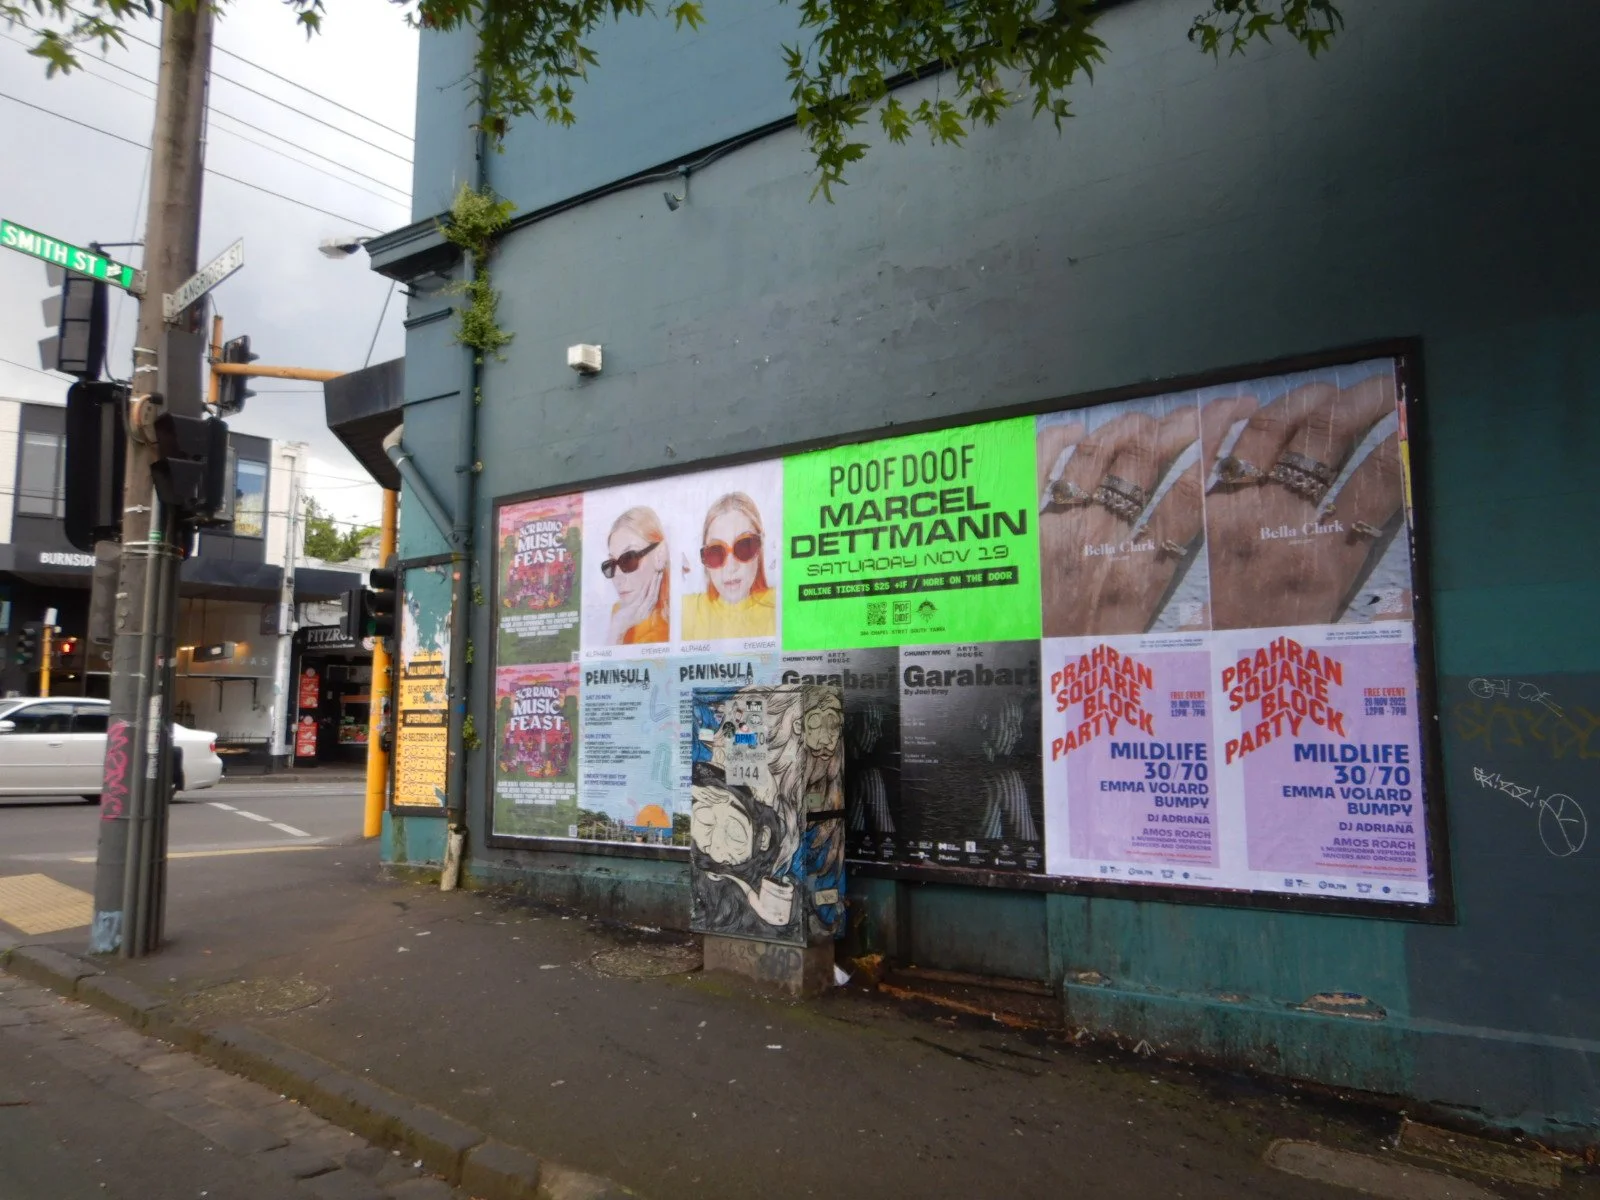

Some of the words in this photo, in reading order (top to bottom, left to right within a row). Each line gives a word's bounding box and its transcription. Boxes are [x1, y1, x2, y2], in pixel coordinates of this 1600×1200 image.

[2, 225, 68, 265] SMITH
[73, 251, 98, 274] ST
[820, 485, 991, 529] MARCEL
[517, 533, 563, 552] MUSIC
[790, 508, 1028, 559] DETTMANN
[1260, 526, 1297, 540] Bella
[514, 548, 567, 568] FEAST
[1084, 543, 1116, 556] Bella
[807, 552, 917, 576] SATURDAY
[924, 548, 970, 565] NOV
[978, 545, 1009, 560] 19
[803, 587, 832, 596] ONLINE
[836, 584, 870, 594] TICKETS
[950, 575, 961, 585] ON
[966, 573, 983, 583] THE
[988, 571, 1013, 581] DOOR
[641, 647, 670, 655] EYEWEAR
[680, 662, 754, 682] PENINSULA
[1051, 643, 1153, 695] PRAHRAN
[1222, 635, 1342, 692] PRAHRAN
[585, 668, 650, 686] PENINSULA
[903, 660, 1038, 688] Garabari
[533, 686, 560, 698] RADIO
[1056, 664, 1141, 713] SQUARE
[1229, 659, 1329, 712] SQUARE
[1364, 688, 1380, 696] FREE
[1382, 688, 1405, 696] EVENT
[513, 699, 561, 716] MUSIC
[1374, 697, 1388, 706] NOV
[1391, 706, 1407, 716] 7PM
[1083, 690, 1154, 737] BLOCK
[1261, 685, 1346, 738] BLOCK
[510, 715, 565, 731] FEAST
[1051, 711, 1118, 761] PARTY
[1225, 709, 1304, 765] PARTY
[1110, 742, 1208, 761] MILDLIFE
[1294, 743, 1410, 764] MILDLIFE
[1144, 762, 1208, 781] 30/70
[1334, 765, 1411, 786] 30/70
[1100, 780, 1145, 793] EMMA
[1148, 782, 1209, 795] VOLARD
[1282, 785, 1335, 799] EMMA
[1339, 786, 1412, 801] VOLARD
[1154, 796, 1209, 809] BUMPY
[1347, 802, 1413, 817] BUMPY
[1147, 814, 1159, 822] DJ
[1161, 814, 1210, 824] ADRIANA
[1339, 821, 1352, 831] DJ
[1356, 822, 1414, 834] ADRIANA
[1142, 828, 1173, 837] AMOS
[1175, 829, 1211, 839] ROACH
[1333, 838, 1369, 848] AMOS
[1371, 839, 1416, 850] ROACH
